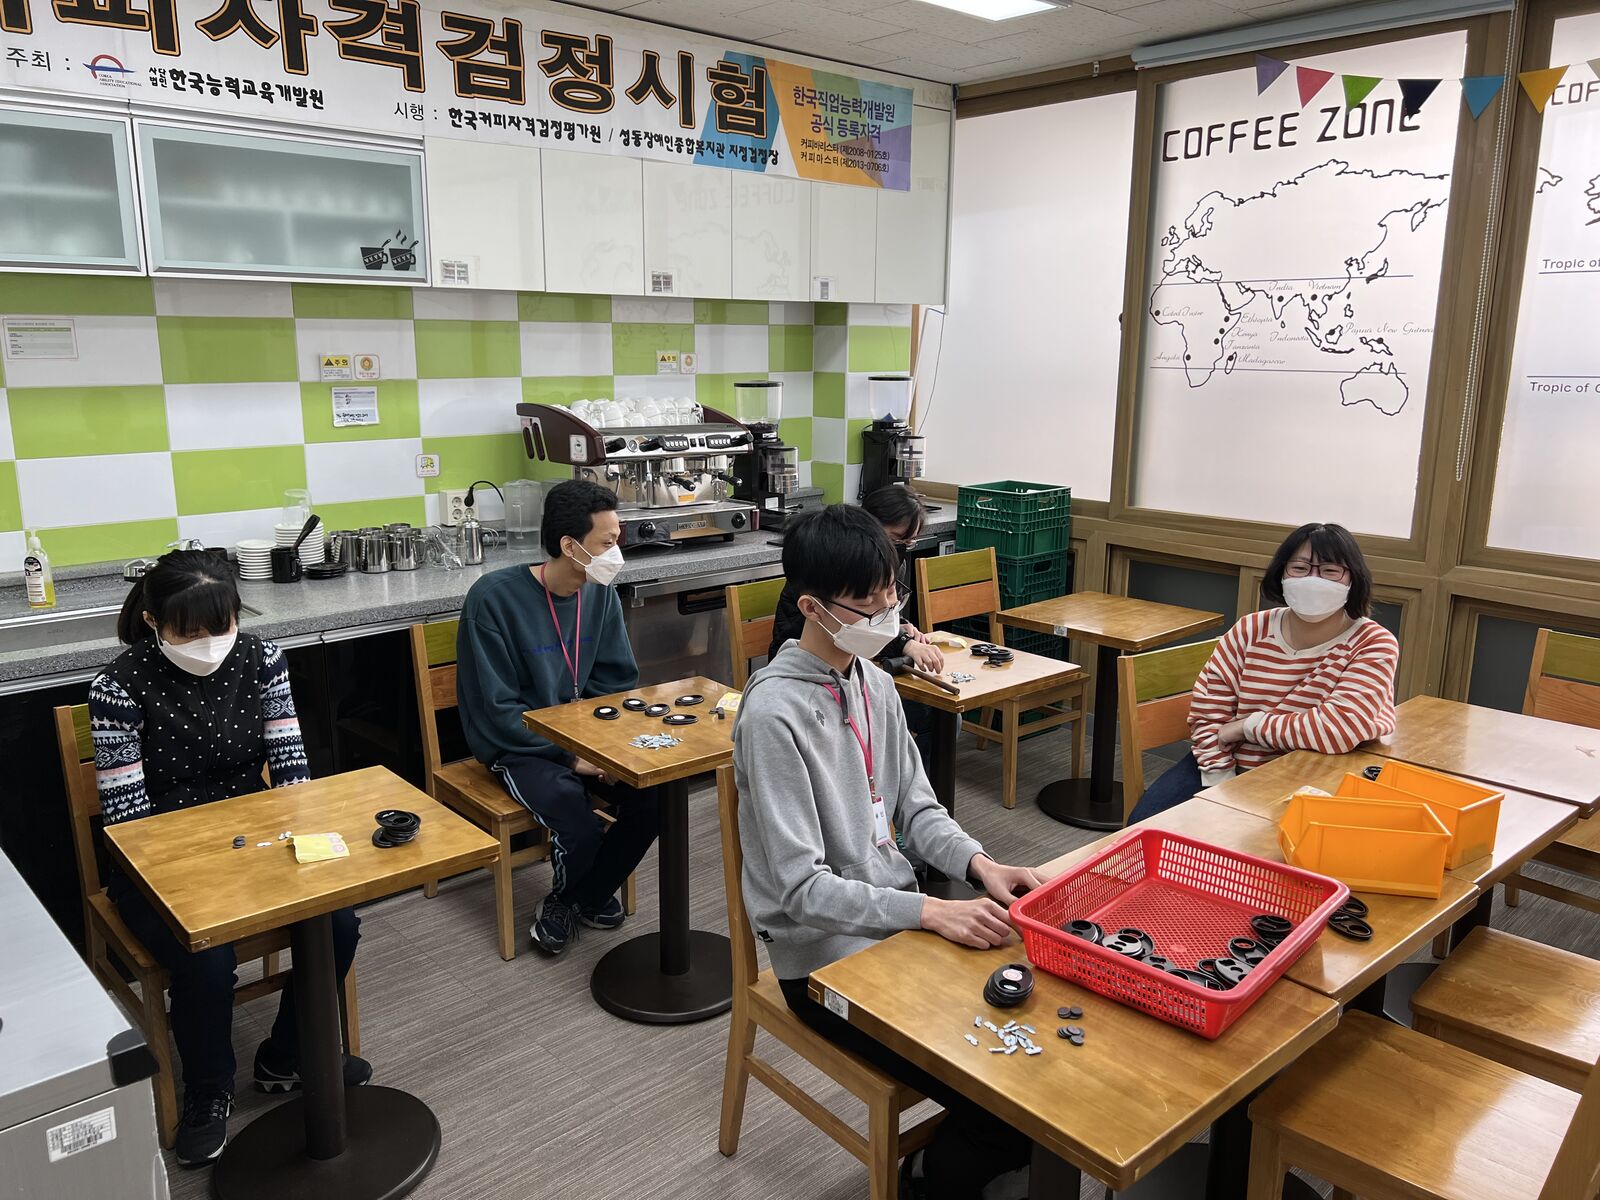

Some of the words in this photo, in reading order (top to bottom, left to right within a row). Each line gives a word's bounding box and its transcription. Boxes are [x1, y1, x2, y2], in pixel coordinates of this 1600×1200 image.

[6, 47, 51, 71] 주최
[149, 67, 166, 75] 사단
[149, 76, 167, 88] 법인
[169, 68, 324, 110] 한국능력교육개발원
[793, 86, 895, 123] 한국직업능력개발원
[394, 102, 425, 122] 시행
[449, 107, 601, 144] 한국커피자격검정평가원
[619, 128, 725, 159] 성동장애인종합복지관
[729, 145, 779, 166] 지정검정장
[811, 114, 834, 136] 공식
[837, 118, 881, 144] 등록자격
[1162, 112, 1299, 162] COFFEE
[800, 138, 839, 154] 커피바리스타
[1542, 259, 1585, 270] Tropic
[1269, 281, 1293, 291] India
[1309, 279, 1341, 290] Vietnam
[1530, 381, 1572, 394] Tropic
[1575, 382, 1590, 393] of
